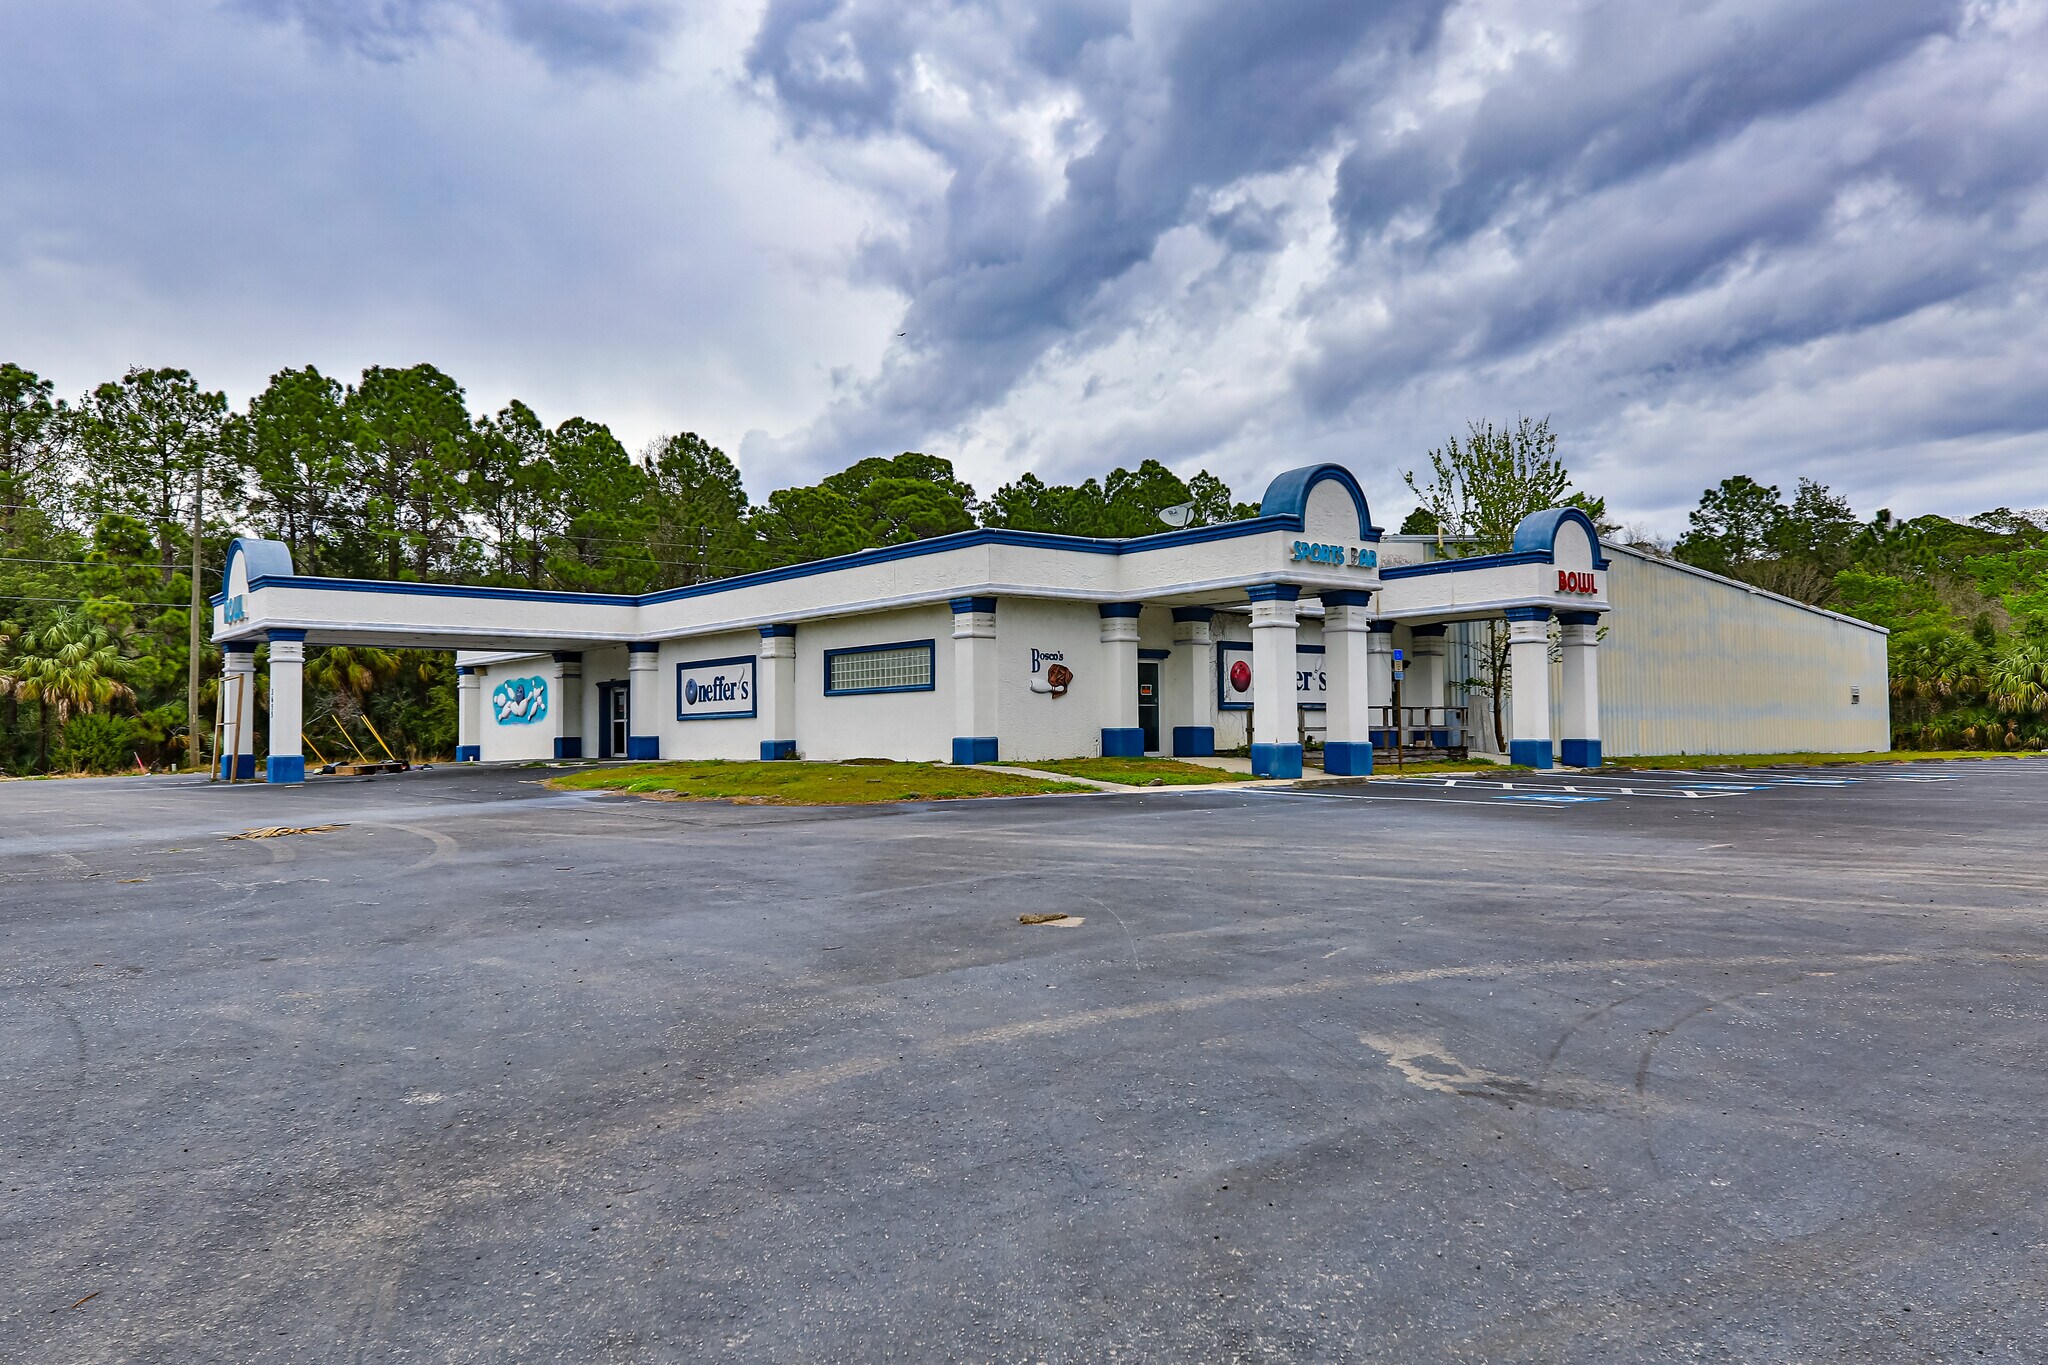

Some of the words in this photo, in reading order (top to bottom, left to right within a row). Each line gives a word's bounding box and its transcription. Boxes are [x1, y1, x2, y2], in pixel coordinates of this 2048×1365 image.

[1293, 540, 1345, 566] SPORTS
[1350, 547, 1377, 568] BAR
[1557, 569, 1598, 594] BOWL
[1030, 647, 1064, 673] Bosco's
[685, 668, 749, 705] Oneffer's
